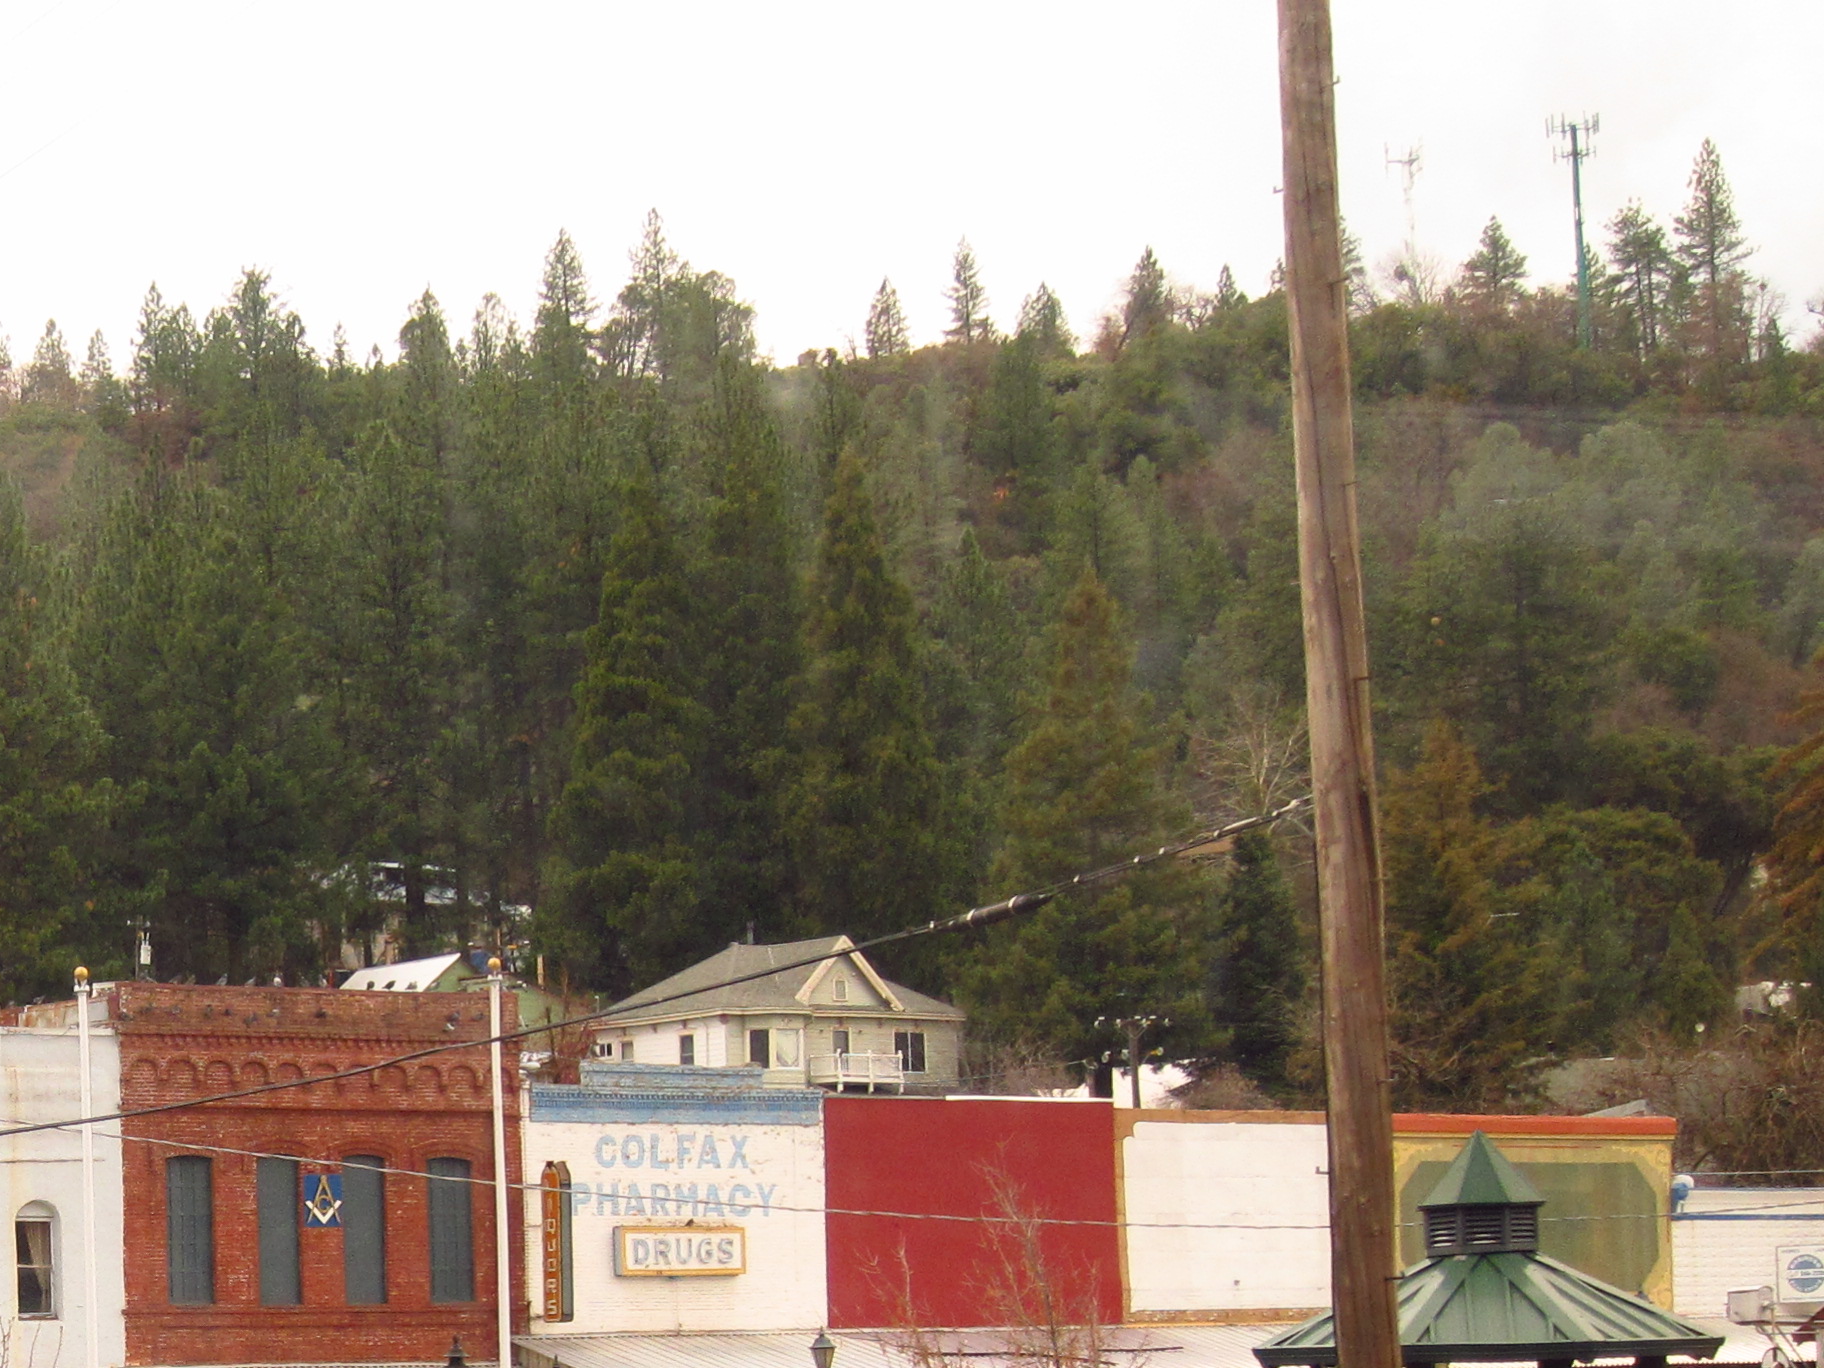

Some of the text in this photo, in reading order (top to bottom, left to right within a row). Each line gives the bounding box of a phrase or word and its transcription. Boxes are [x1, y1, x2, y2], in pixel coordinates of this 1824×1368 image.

[594, 1133, 751, 1169] COLFAX
[572, 1182, 777, 1218] PHARMACY
[632, 1238, 735, 1266] DRUGS
